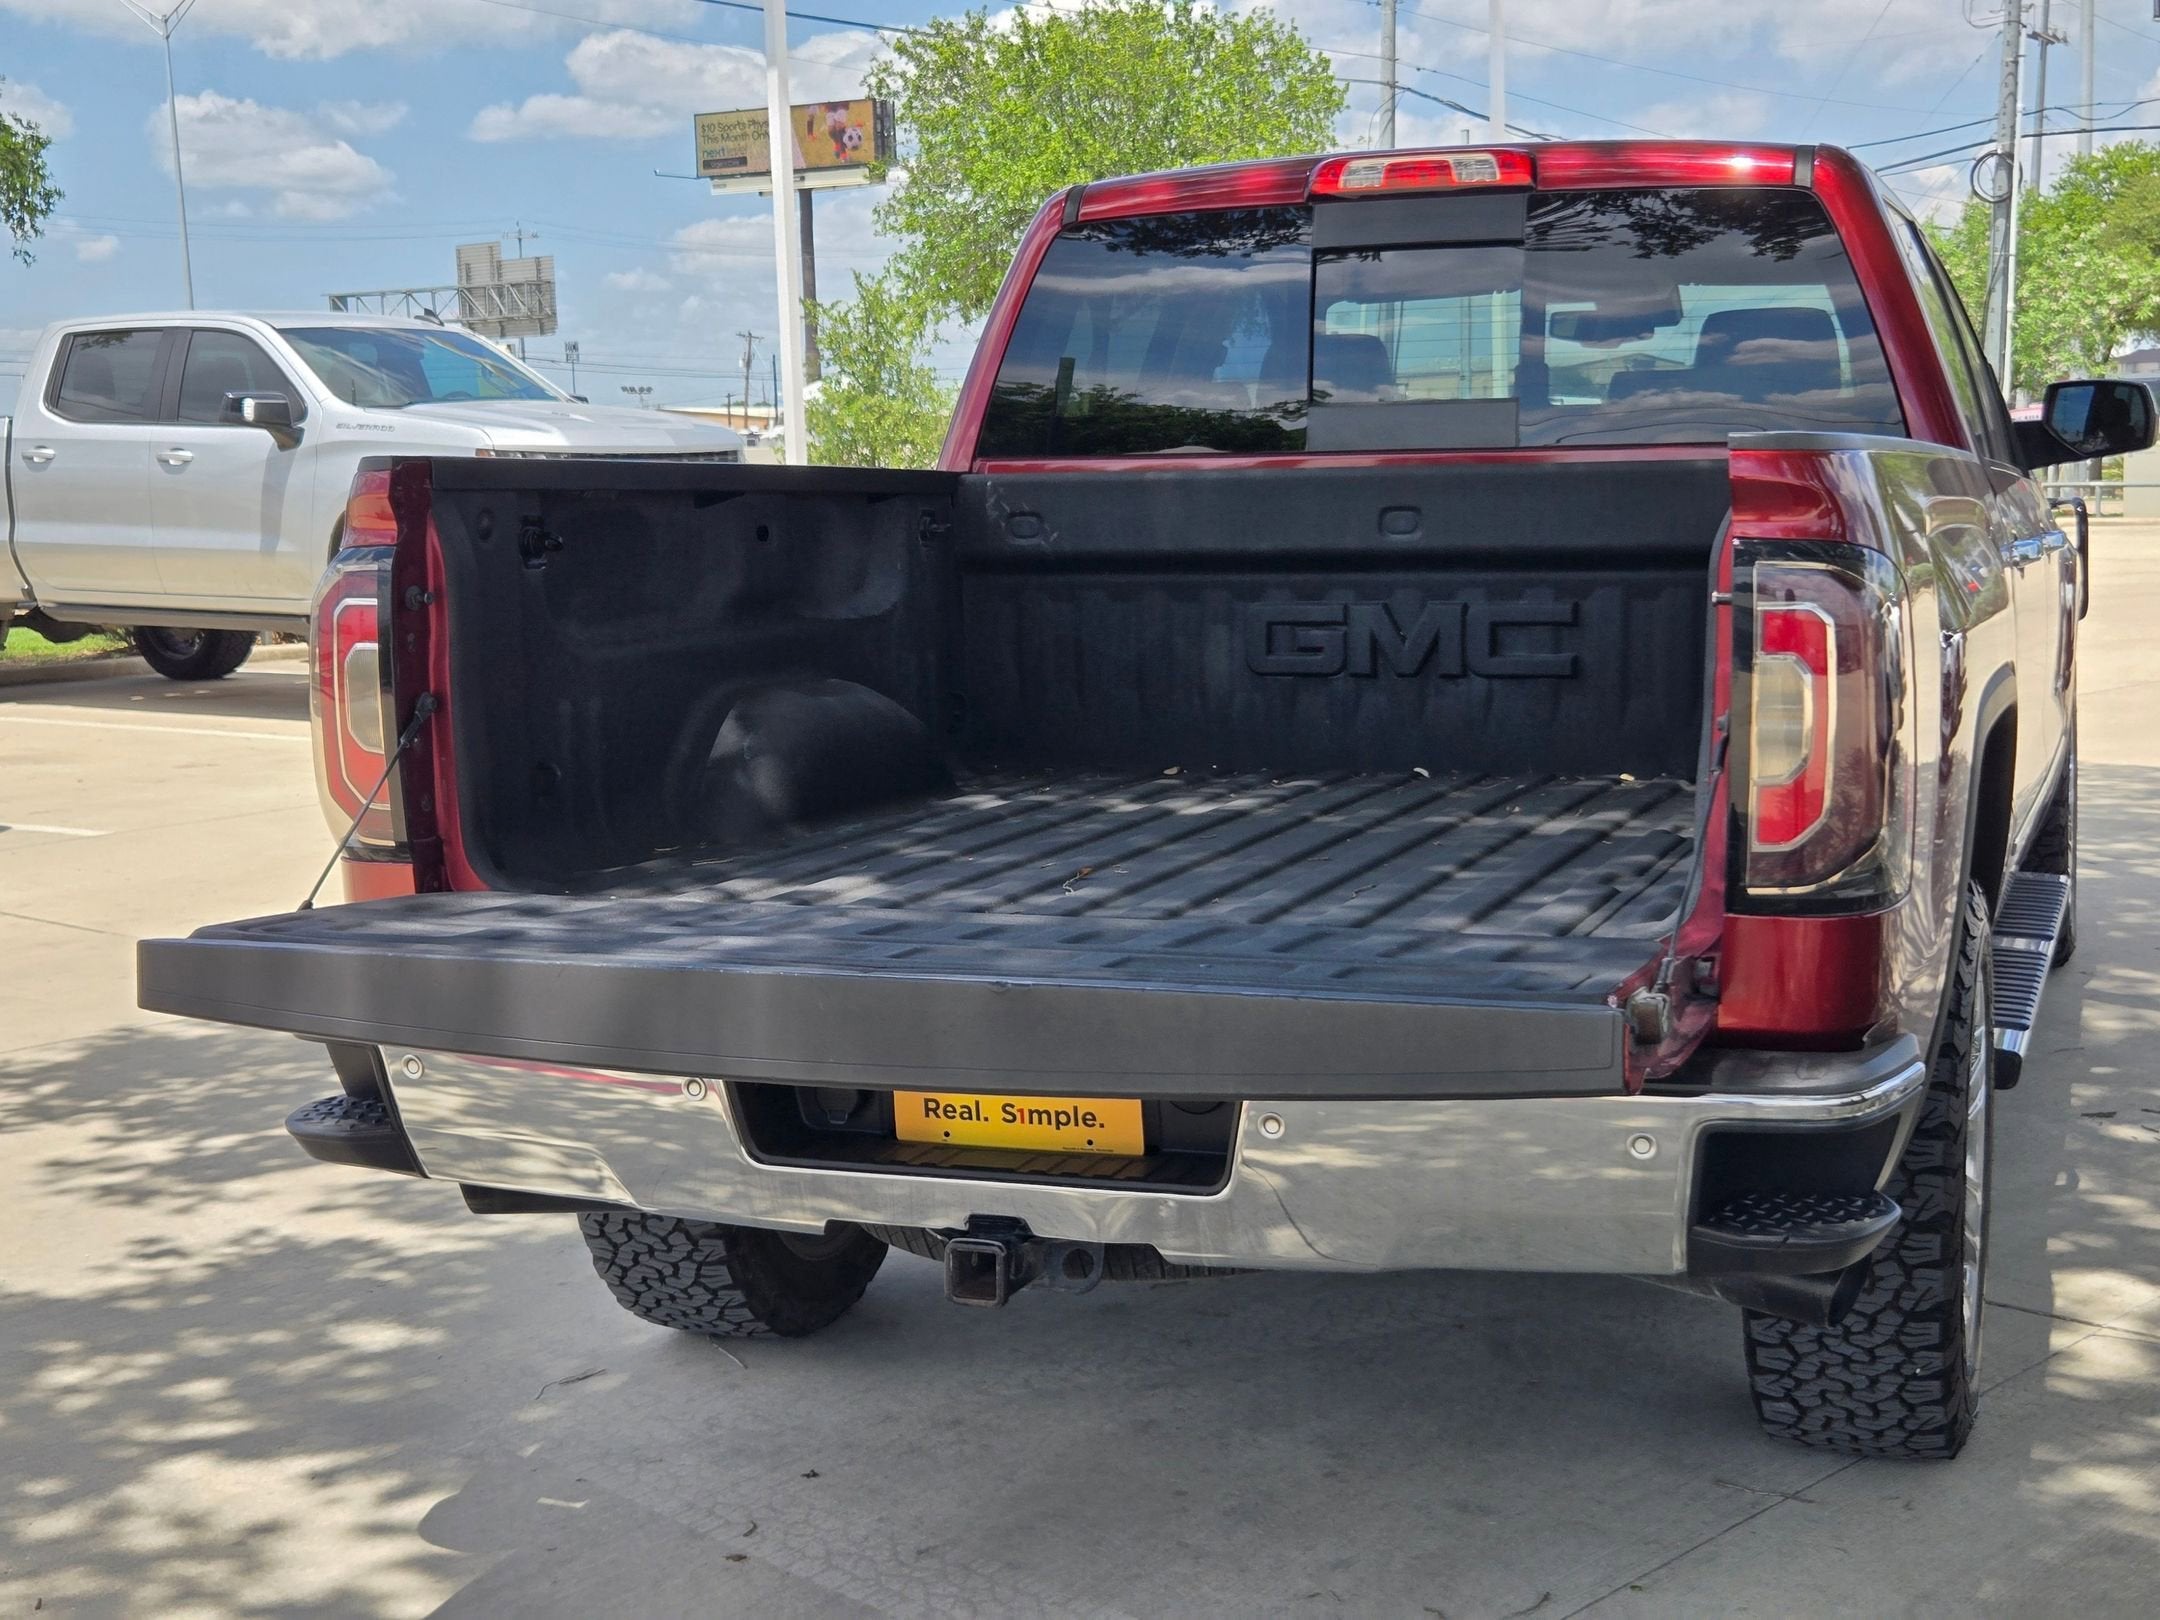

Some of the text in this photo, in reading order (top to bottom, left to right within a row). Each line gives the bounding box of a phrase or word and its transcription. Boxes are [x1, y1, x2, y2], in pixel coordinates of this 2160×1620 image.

[702, 123, 716, 133] $10
[718, 120, 746, 133] Sports
[703, 134, 720, 144] This
[721, 131, 749, 142] Month
[1246, 602, 1579, 679] GMC
[923, 1098, 989, 1122] Real.
